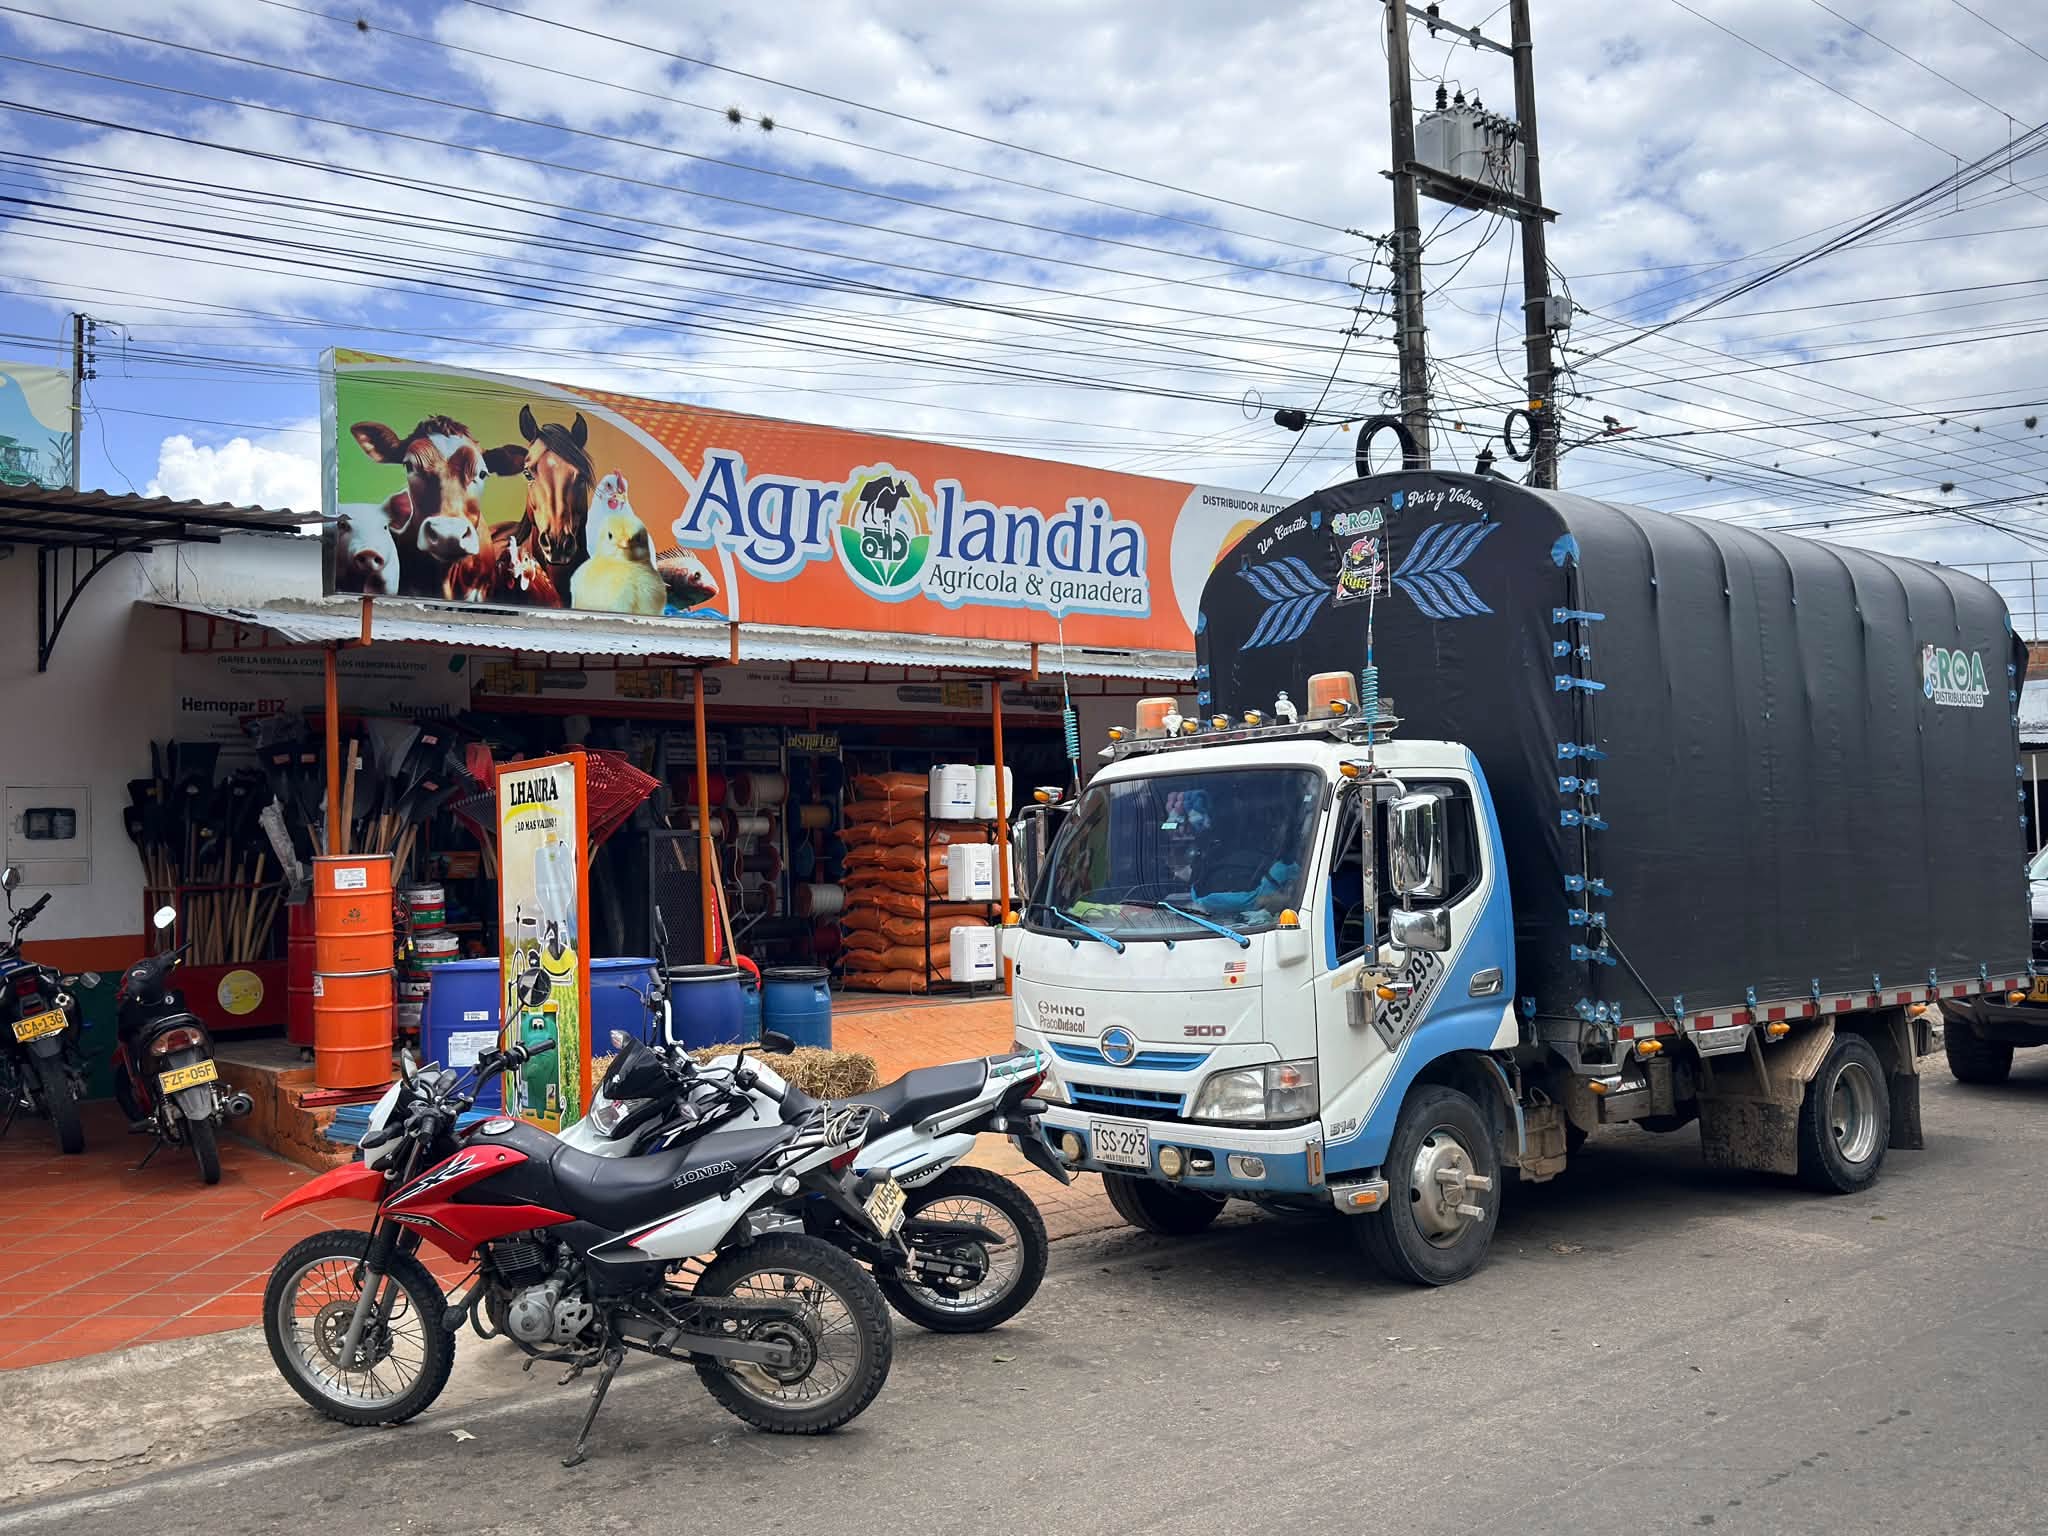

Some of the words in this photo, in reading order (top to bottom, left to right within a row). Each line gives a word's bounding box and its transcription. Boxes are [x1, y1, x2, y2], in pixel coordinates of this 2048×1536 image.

[1202, 495, 1259, 513] DISTRIBUIDOR
[1260, 503, 1286, 515] AUTO
[1257, 537, 1274, 555] Un
[1274, 516, 1308, 541] Carrito
[1449, 487, 1484, 511] Volver
[1348, 507, 1384, 529] ROA
[928, 564, 1017, 594] Agrícola
[1025, 573, 1044, 596] &
[1049, 581, 1142, 605] ganadera
[1936, 648, 1988, 692] ROA
[181, 697, 256, 716] Hemopar
[257, 698, 286, 714] B12
[1935, 690, 1983, 706] DISTRIBUCIONES
[510, 775, 559, 807] LHAURA
[1050, 1004, 1085, 1017] HINO
[1039, 1014, 1086, 1033] PracoDidacol
[1183, 1024, 1227, 1037] 300
[672, 1159, 737, 1190] HONDA
